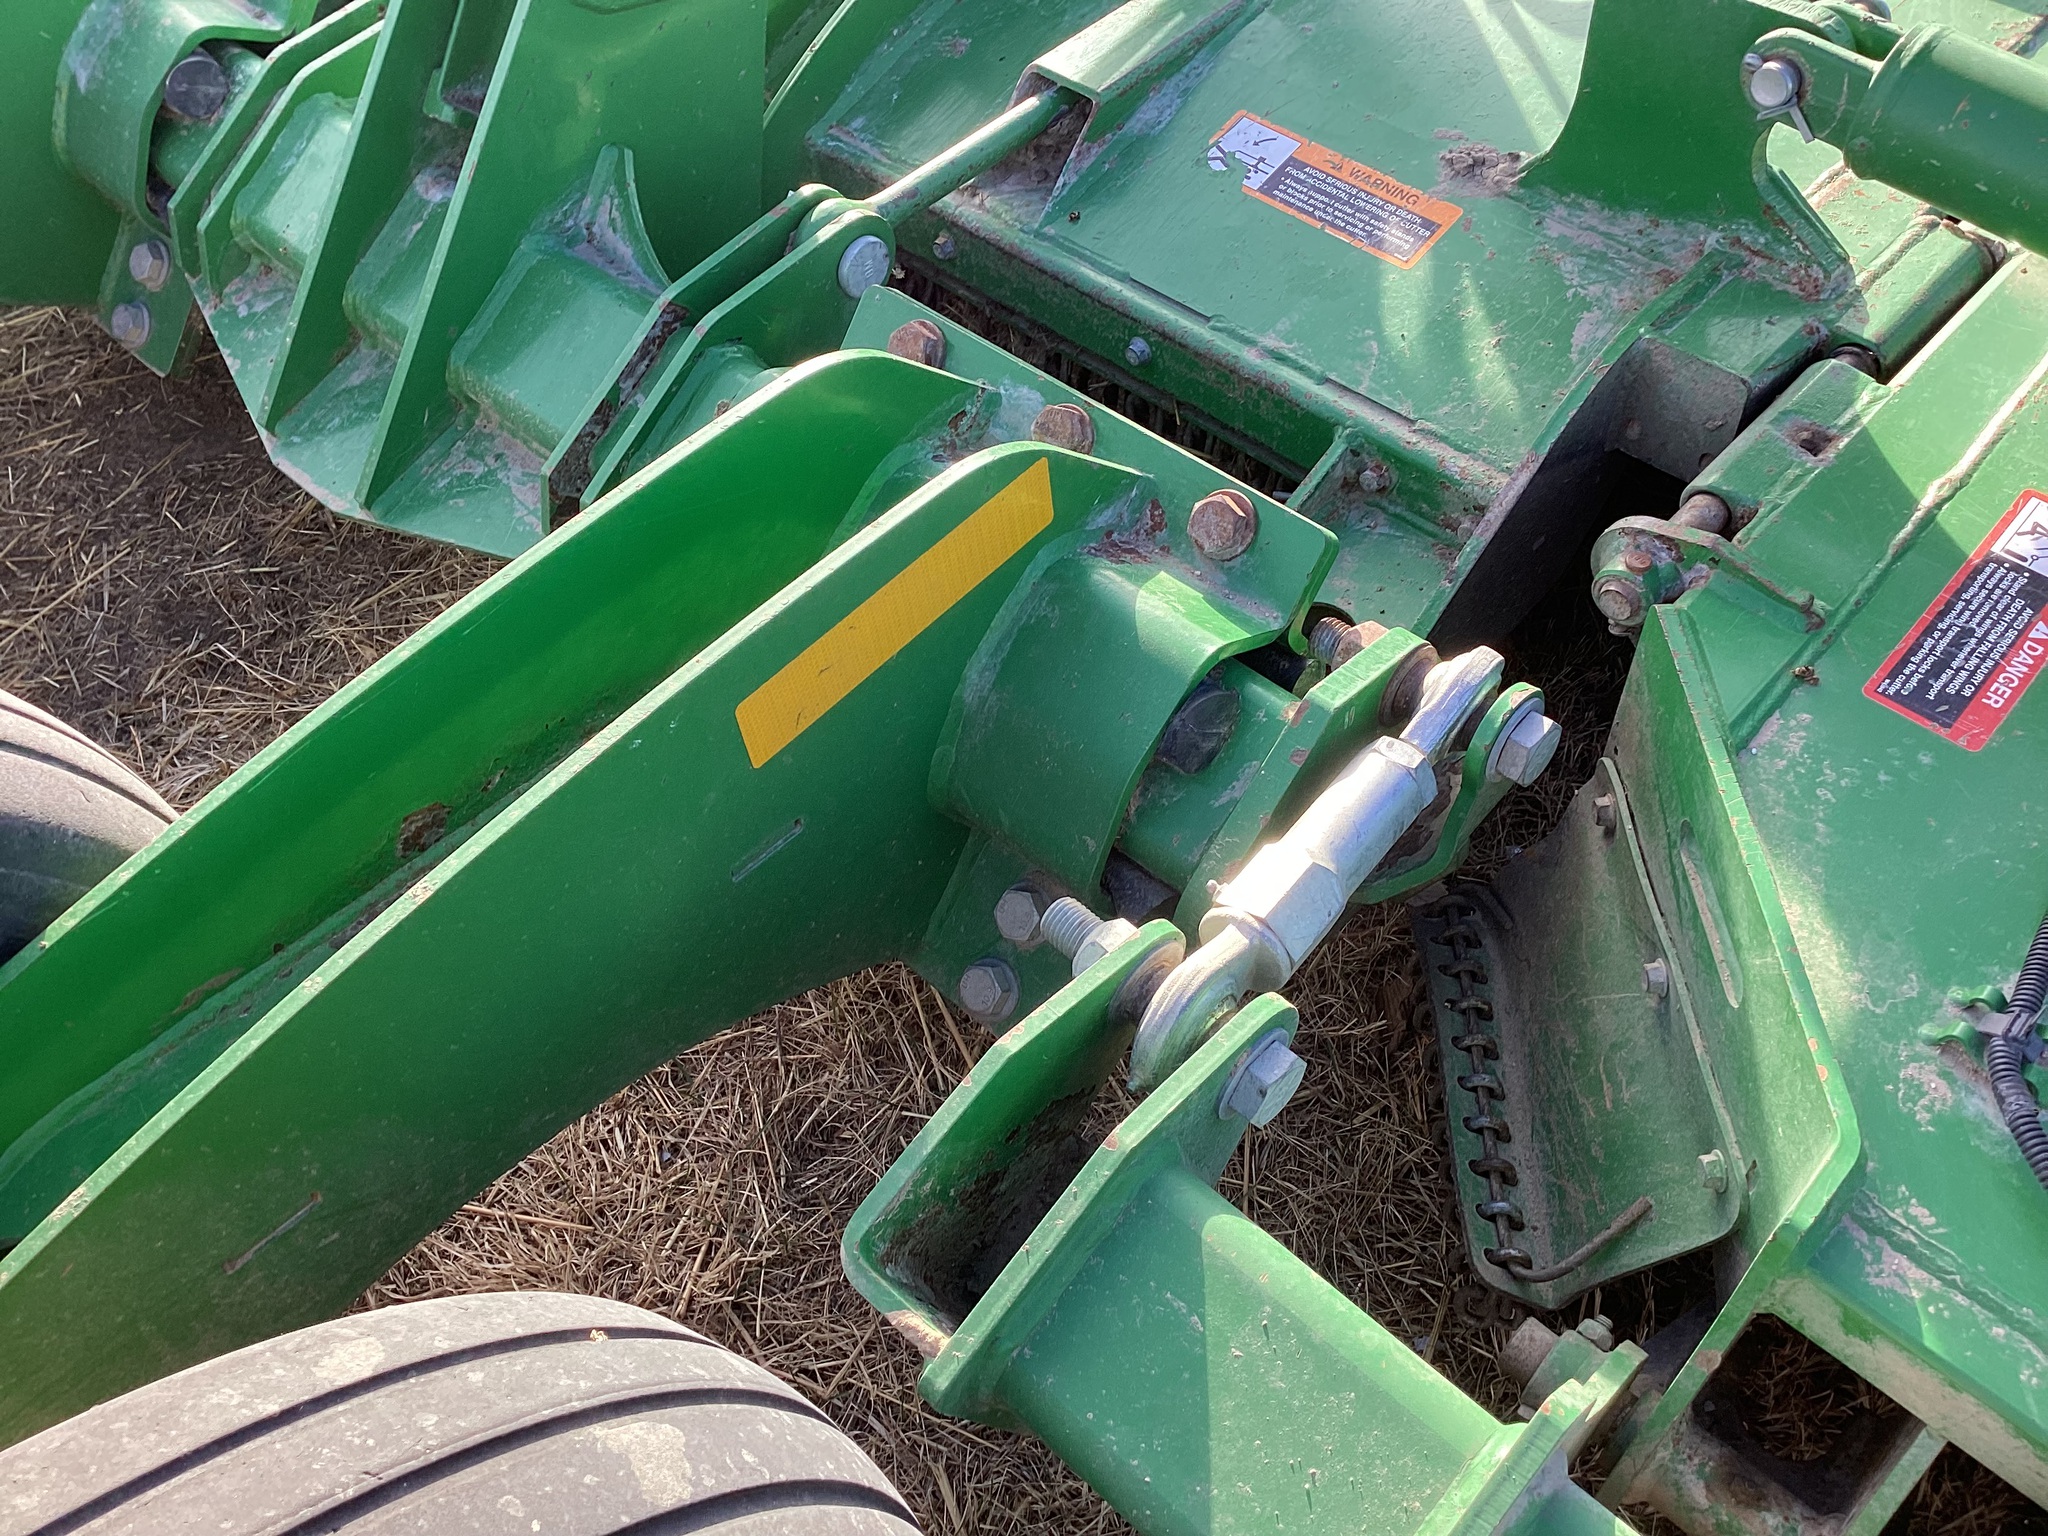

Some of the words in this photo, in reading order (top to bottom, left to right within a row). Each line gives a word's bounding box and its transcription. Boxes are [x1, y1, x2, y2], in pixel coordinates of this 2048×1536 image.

[1302, 165, 1327, 180] AVOID
[1323, 175, 1359, 195] SERIOUS
[1382, 202, 1397, 212] OR
[1394, 208, 1422, 224] DEATH
[1345, 166, 1422, 206] WARNING
[1271, 188, 1315, 212] maintenance
[1333, 218, 1347, 227] the
[1282, 177, 1309, 193] Always
[1332, 200, 1355, 214] cutter
[1353, 210, 1371, 221] with
[1368, 217, 1391, 232] safety
[1390, 227, 1415, 242] stands
[1283, 166, 1307, 180] FROM
[1348, 196, 1390, 218] LOWERING
[1387, 214, 1401, 224] OF
[1398, 219, 1432, 238] CUTTER
[1285, 187, 1309, 201] blocks
[1307, 197, 1326, 210] prior
[1324, 205, 1334, 213] to
[1331, 209, 1366, 228] servicing
[1371, 228, 1411, 250] performing
[1959, 559, 1998, 603] transporting,
[1982, 564, 2007, 591] Always
[1997, 569, 2018, 591] locks
[2006, 573, 2028, 597] Stand
[1967, 587, 1988, 611] secure
[1990, 587, 2002, 600] are
[1994, 593, 2013, 613] clear
[1935, 598, 1967, 633] servicing,
[1953, 607, 1973, 628] wing
[1988, 609, 2000, 621] of
[2001, 595, 2025, 623] DEATH
[1929, 623, 1961, 657] transport
[1930, 629, 1941, 639] or
[1972, 615, 1995, 639] wings
[1985, 619, 2007, 643] FROM
[1908, 636, 1937, 665] parking
[1948, 635, 1980, 670] whenever
[1962, 639, 1992, 671] FALLING
[1988, 627, 2018, 660] SERIOUS
[1901, 661, 1917, 676] the
[1917, 653, 1938, 675] locks
[1968, 656, 1995, 685] INJURY
[1980, 636, 2045, 711] DANGER
[1883, 673, 1908, 697] cutter.
[1922, 666, 1956, 701] transport
[1944, 669, 1969, 695] WINGS
[1959, 682, 1975, 697] OR
